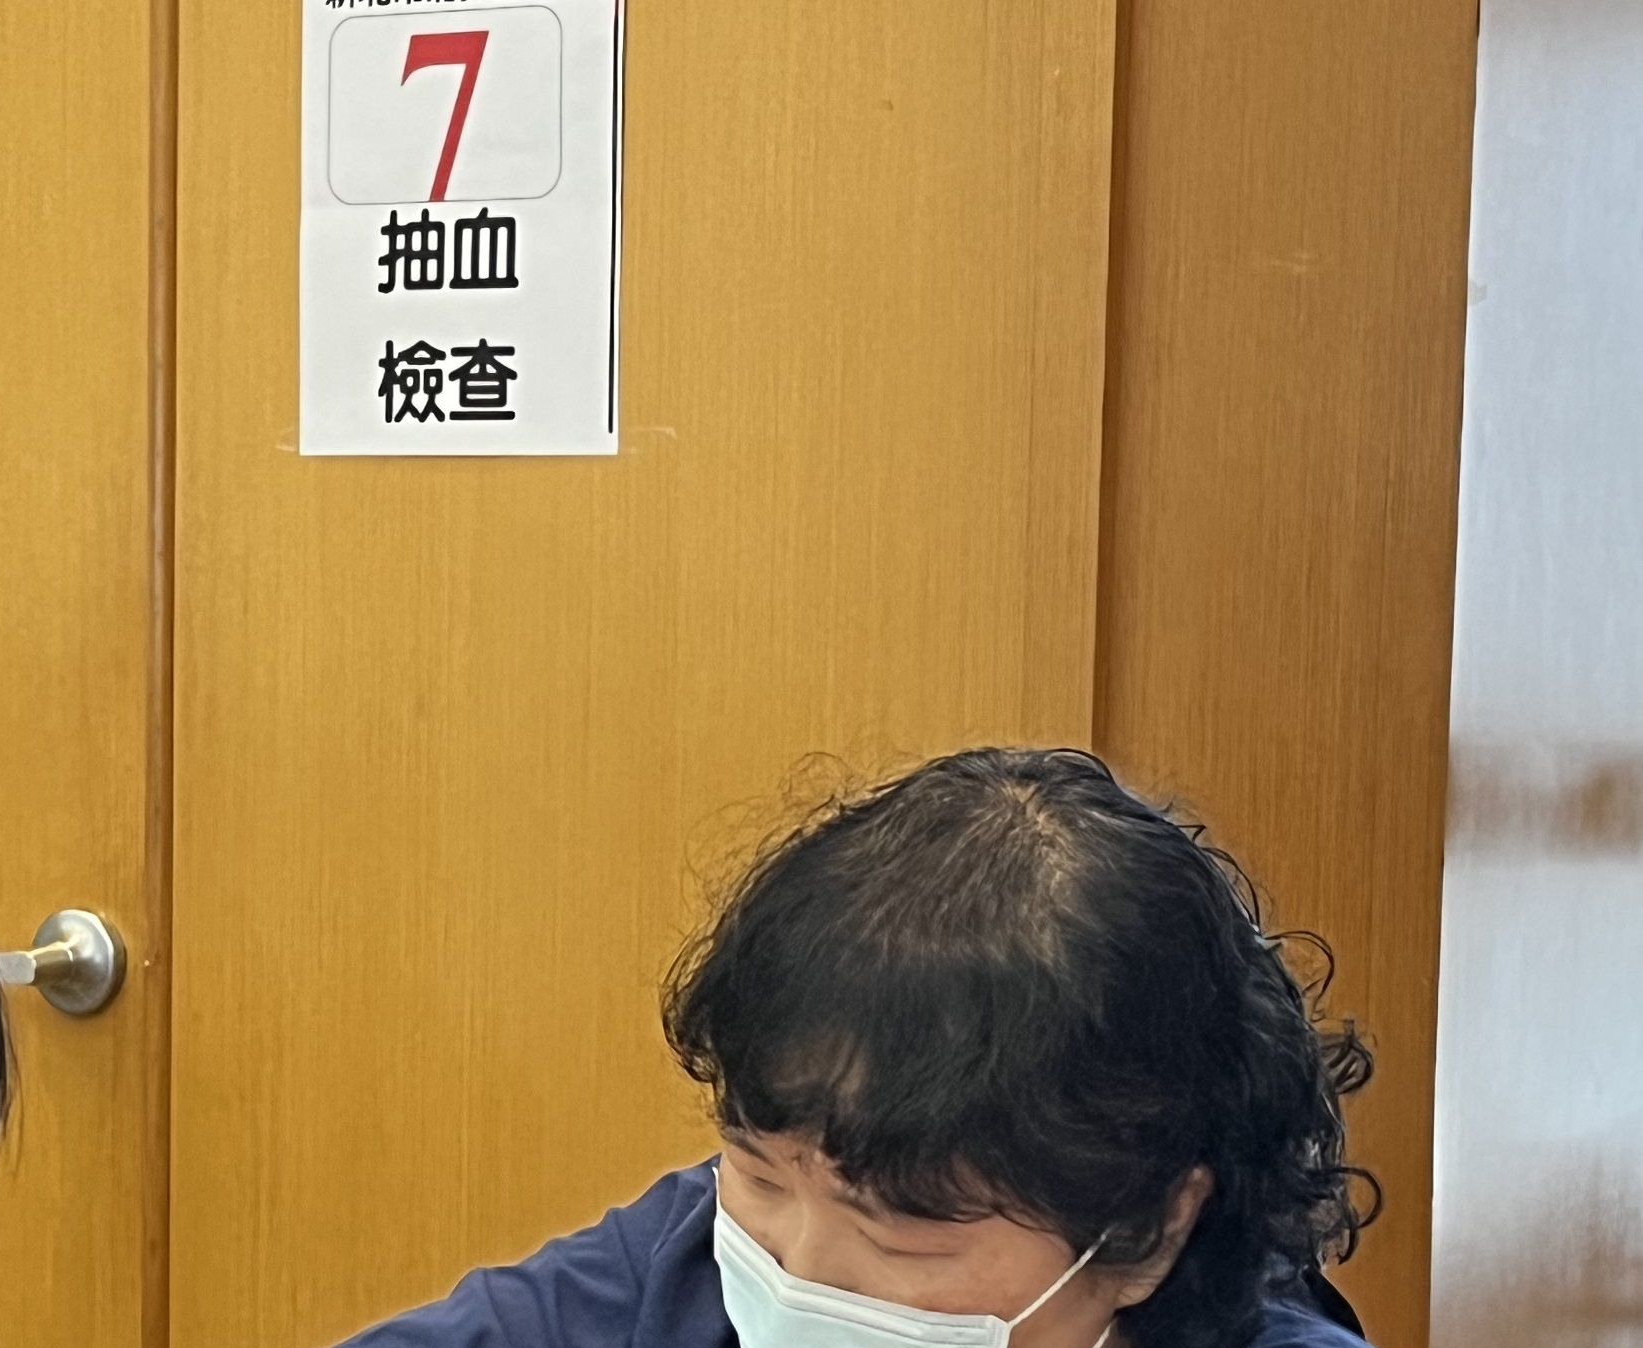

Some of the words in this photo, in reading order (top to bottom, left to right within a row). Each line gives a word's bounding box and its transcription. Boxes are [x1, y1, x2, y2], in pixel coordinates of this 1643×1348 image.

[401, 31, 489, 202] 7
[378, 207, 519, 293] 抽血
[378, 338, 518, 423] 檢查
